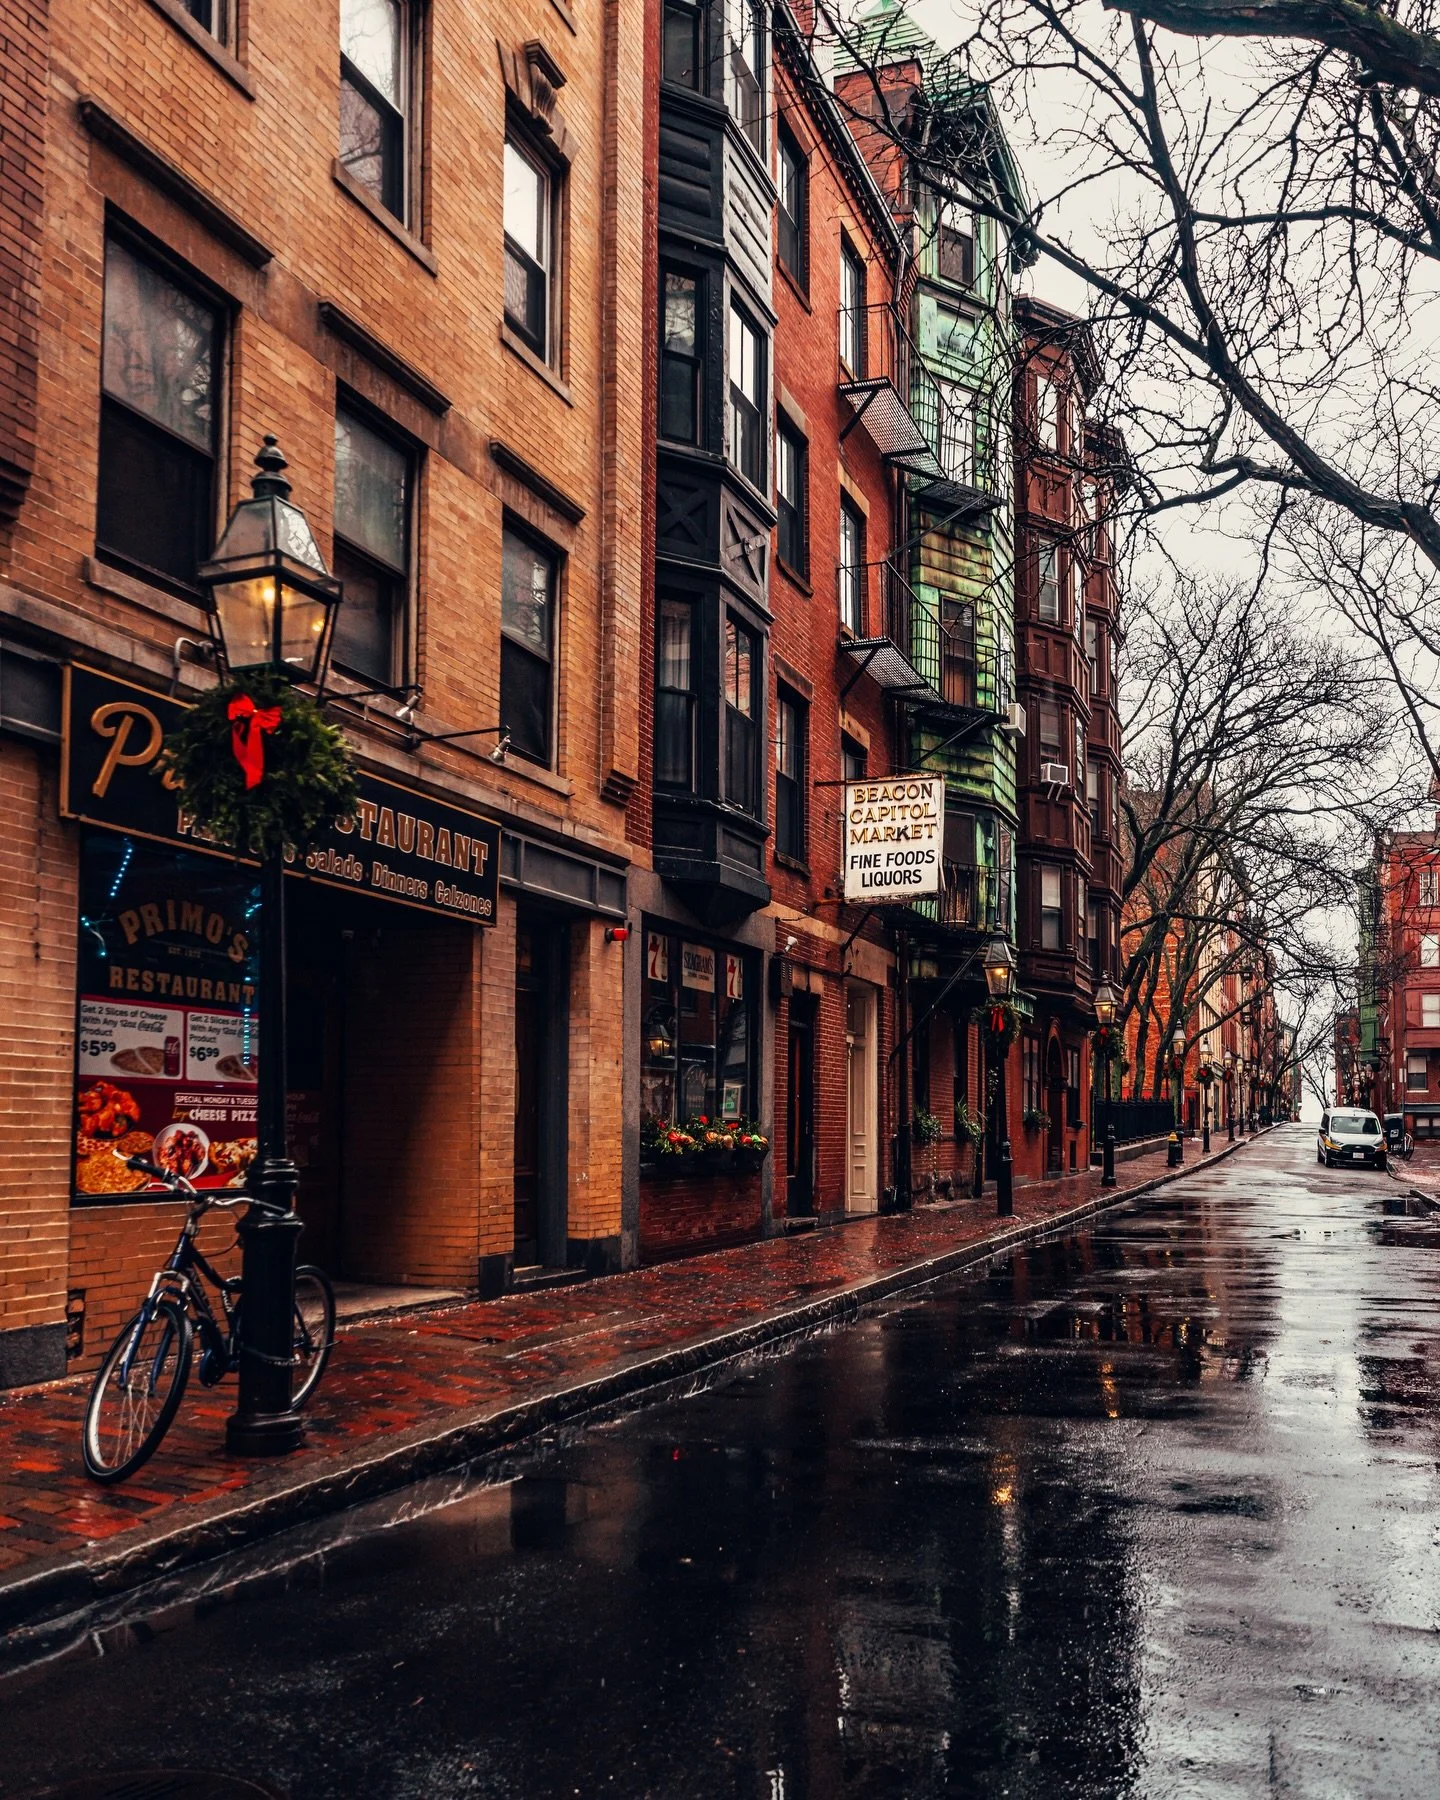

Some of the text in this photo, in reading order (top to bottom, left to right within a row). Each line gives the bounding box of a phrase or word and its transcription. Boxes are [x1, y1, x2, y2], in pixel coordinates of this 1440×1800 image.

[854, 783, 933, 804] BEACON
[850, 803, 937, 824] CAPITOL
[334, 798, 489, 876] TAURANT
[850, 823, 937, 844] MARKET
[851, 850, 935, 870] FINE FOODS
[306, 843, 363, 881] Salads
[371, 861, 428, 899] Dinners
[435, 880, 491, 916] Calzones
[862, 869, 922, 888] LIQUORS
[118, 900, 248, 963] PRIMO'S
[110, 965, 255, 1004] RESTAURANT
[81, 1004, 167, 1021] Get 2 Slices of Cheese
[81, 1016, 101, 1024] With
[102, 1018, 118, 1027] Any
[190, 1014, 202, 1022] Get
[204, 1015, 209, 1023] 2
[210, 1016, 230, 1025] Slices
[231, 1018, 238, 1026] of
[80, 1027, 113, 1036] Product
[189, 1034, 217, 1043] Product
[190, 1024, 206, 1032] With
[208, 1026, 221, 1035] Any
[175, 1095, 202, 1104] SPECIAL
[203, 1096, 230, 1105] MONDAY
[189, 1107, 227, 1121] CHEESE
